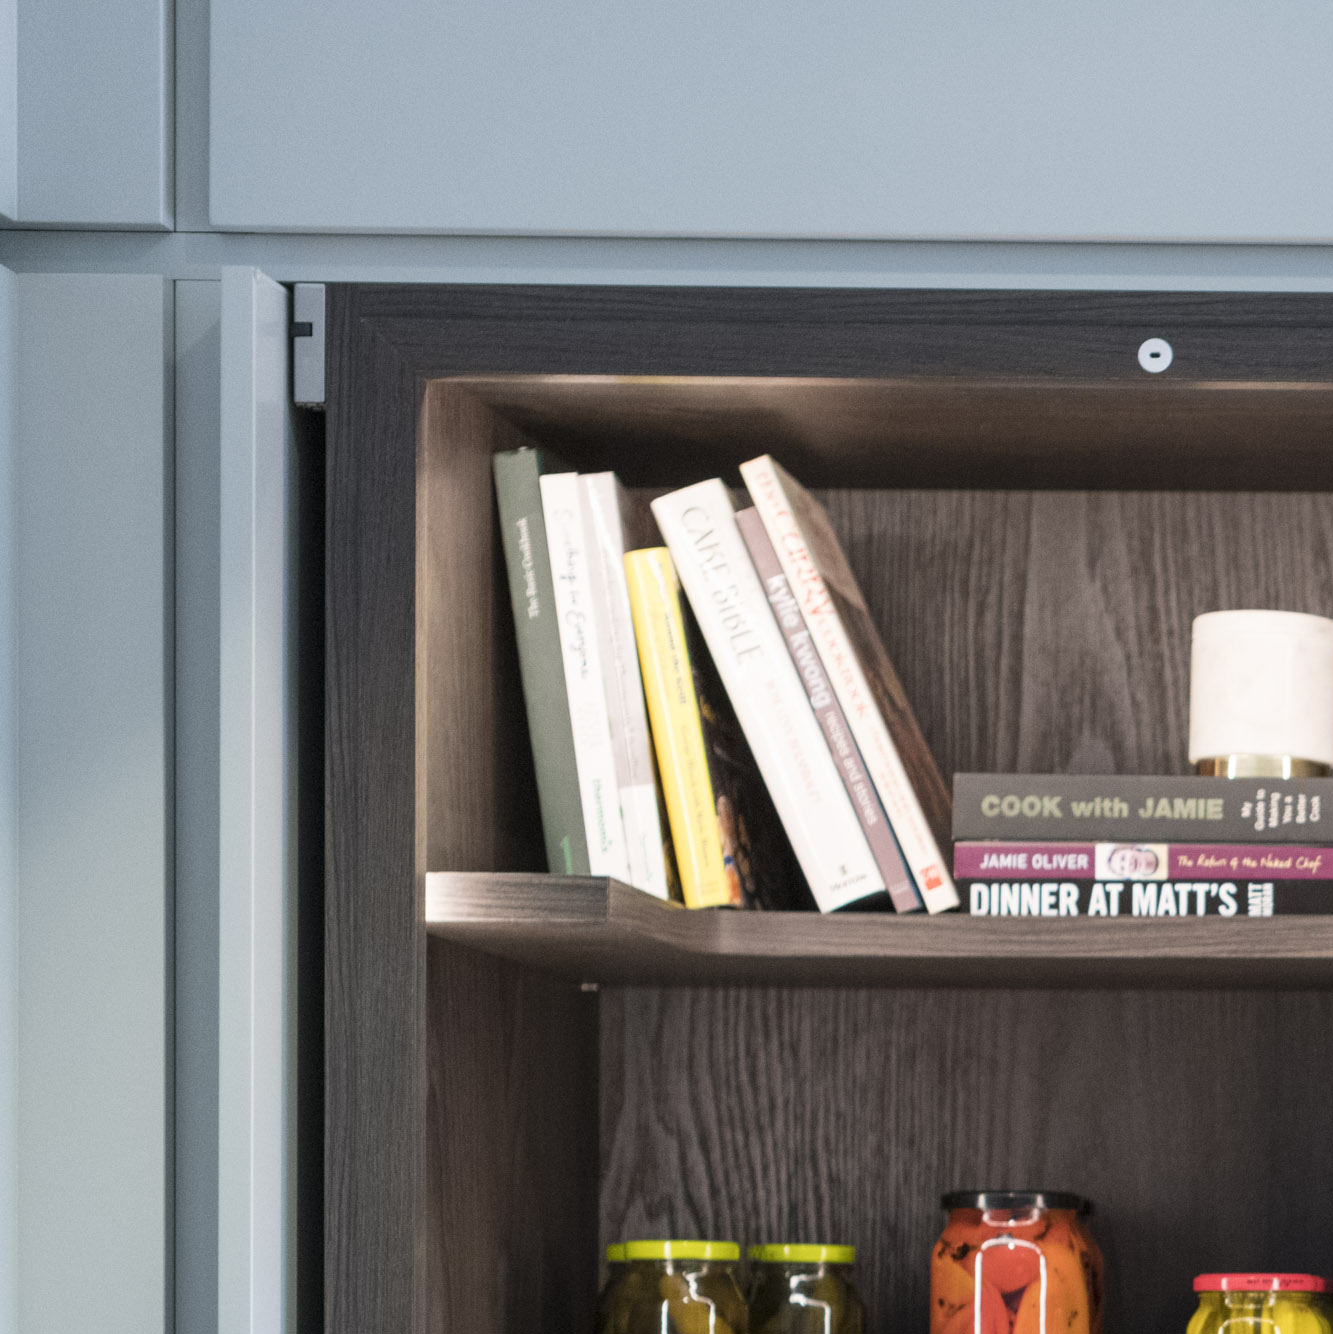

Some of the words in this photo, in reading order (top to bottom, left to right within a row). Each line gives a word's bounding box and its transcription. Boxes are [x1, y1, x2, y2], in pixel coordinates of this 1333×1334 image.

[763, 572, 803, 631] kylie
[786, 629, 835, 710] kwong
[822, 709, 851, 757] recipes
[842, 755, 860, 779] and
[852, 780, 880, 827] stories
[981, 795, 1063, 818] COOK
[1071, 797, 1129, 818] with
[1138, 798, 1224, 820] JAMIE
[979, 853, 1028, 870] JAMIE
[1031, 853, 1089, 870] OLIVER
[1177, 855, 1194, 868] The
[1241, 855, 1258, 868] the
[1296, 856, 1323, 875] Chef
[969, 883, 1080, 917] DINNER
[1087, 882, 1125, 917] AT
[1131, 882, 1238, 918] MATT'S
[1247, 883, 1260, 917] MATT
